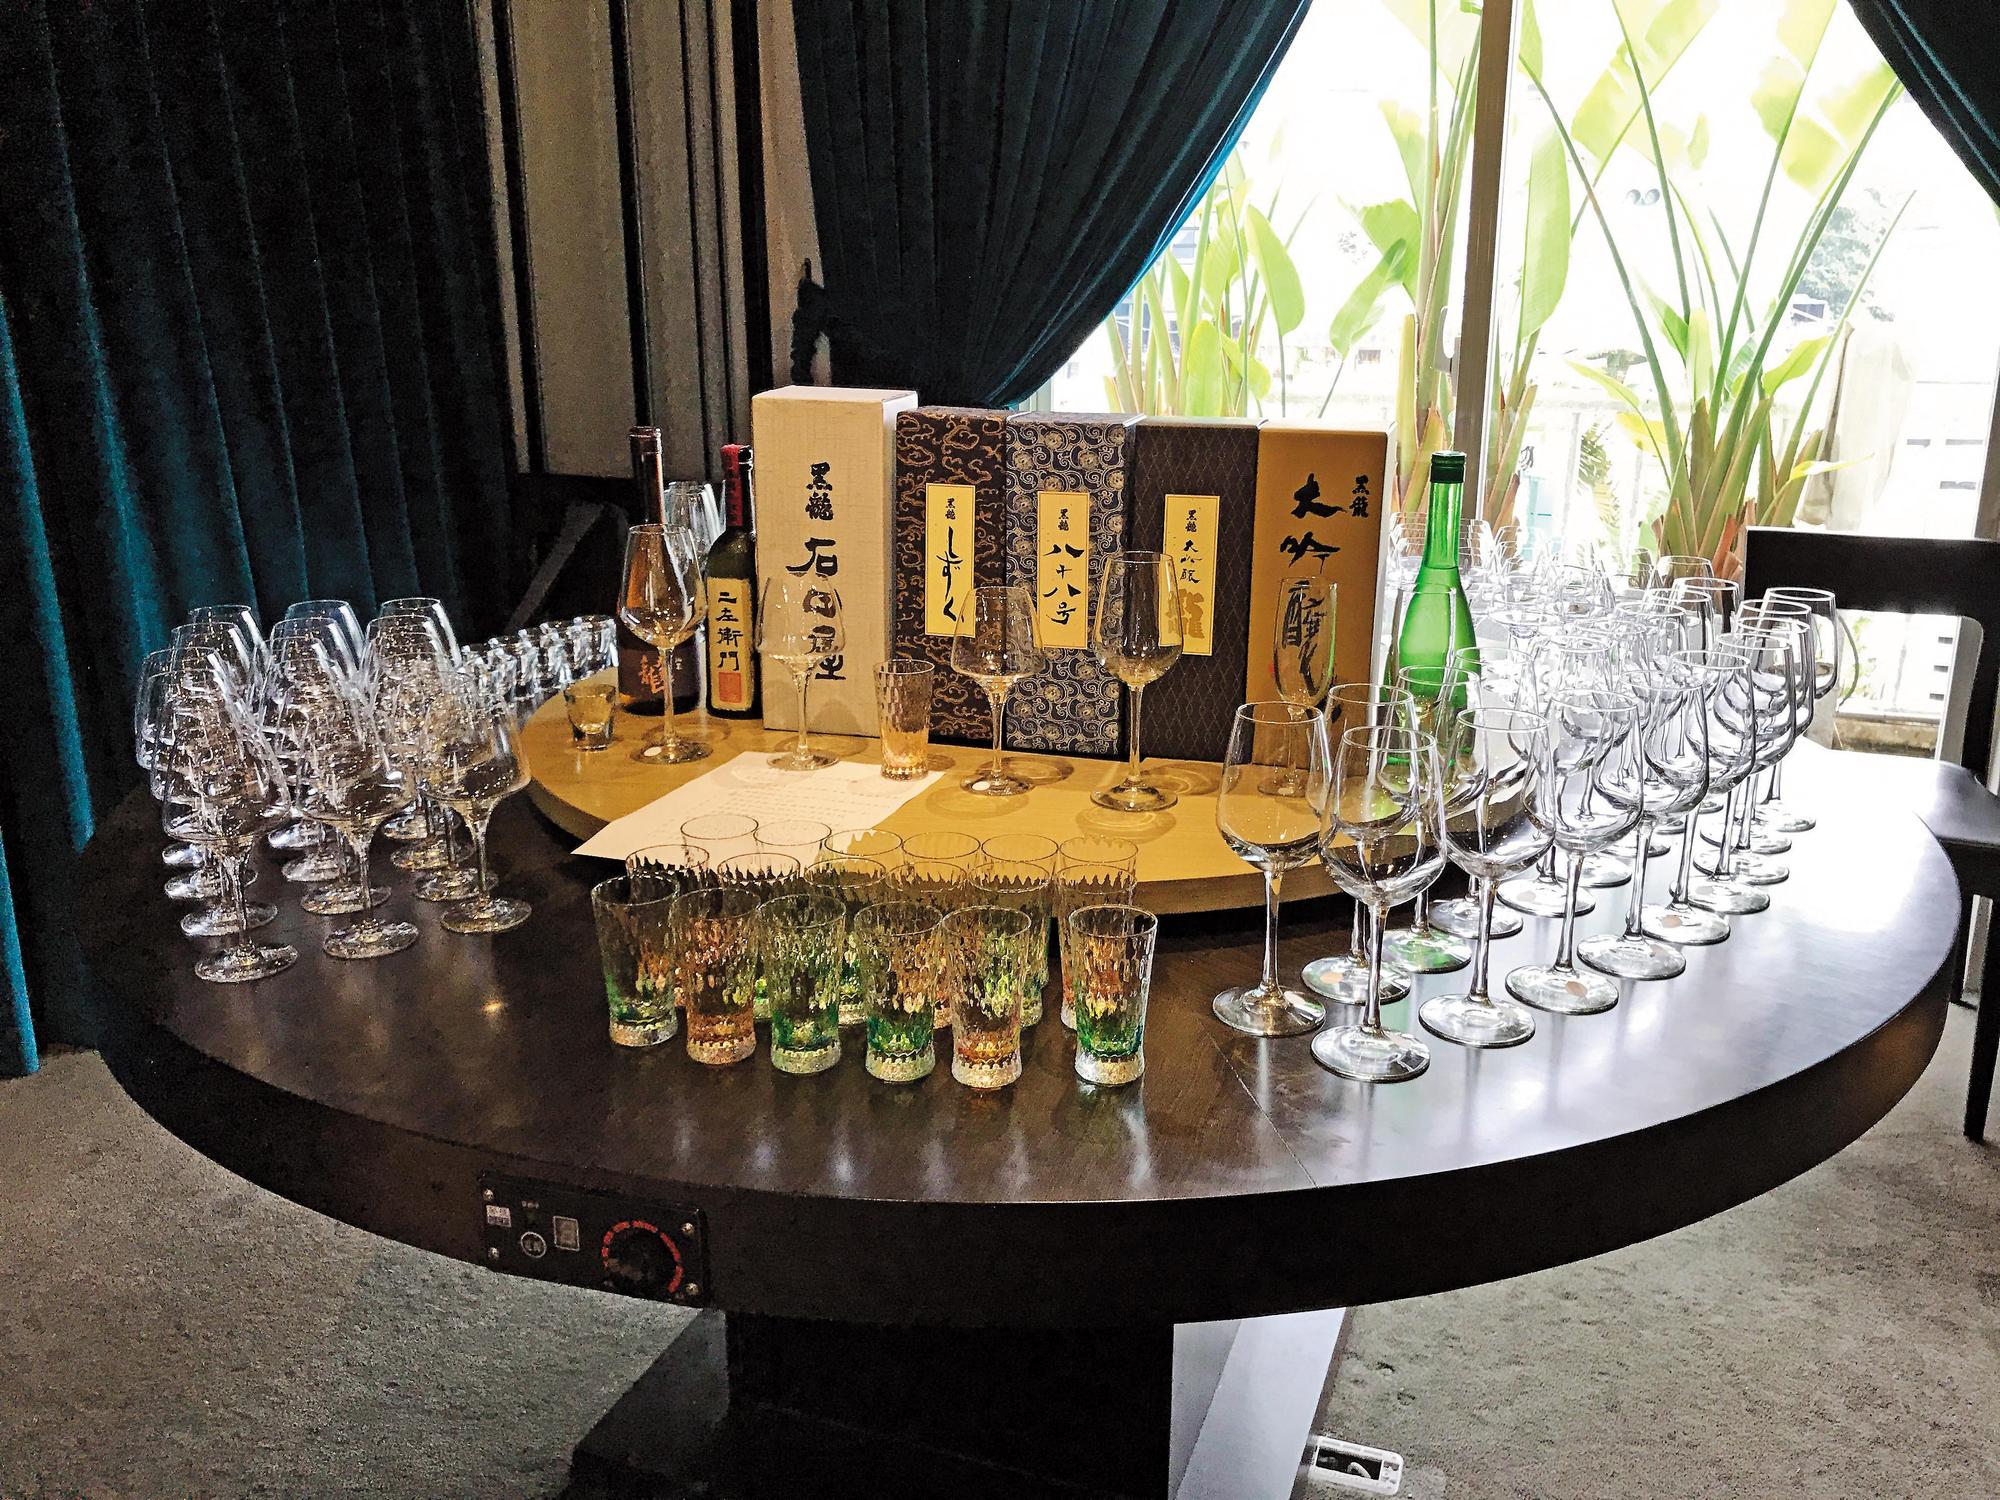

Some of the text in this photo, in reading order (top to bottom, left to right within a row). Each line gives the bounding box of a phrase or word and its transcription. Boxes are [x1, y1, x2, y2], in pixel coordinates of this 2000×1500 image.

[937, 526, 965, 623] しずく
[1043, 544, 1084, 625] 八十八号
